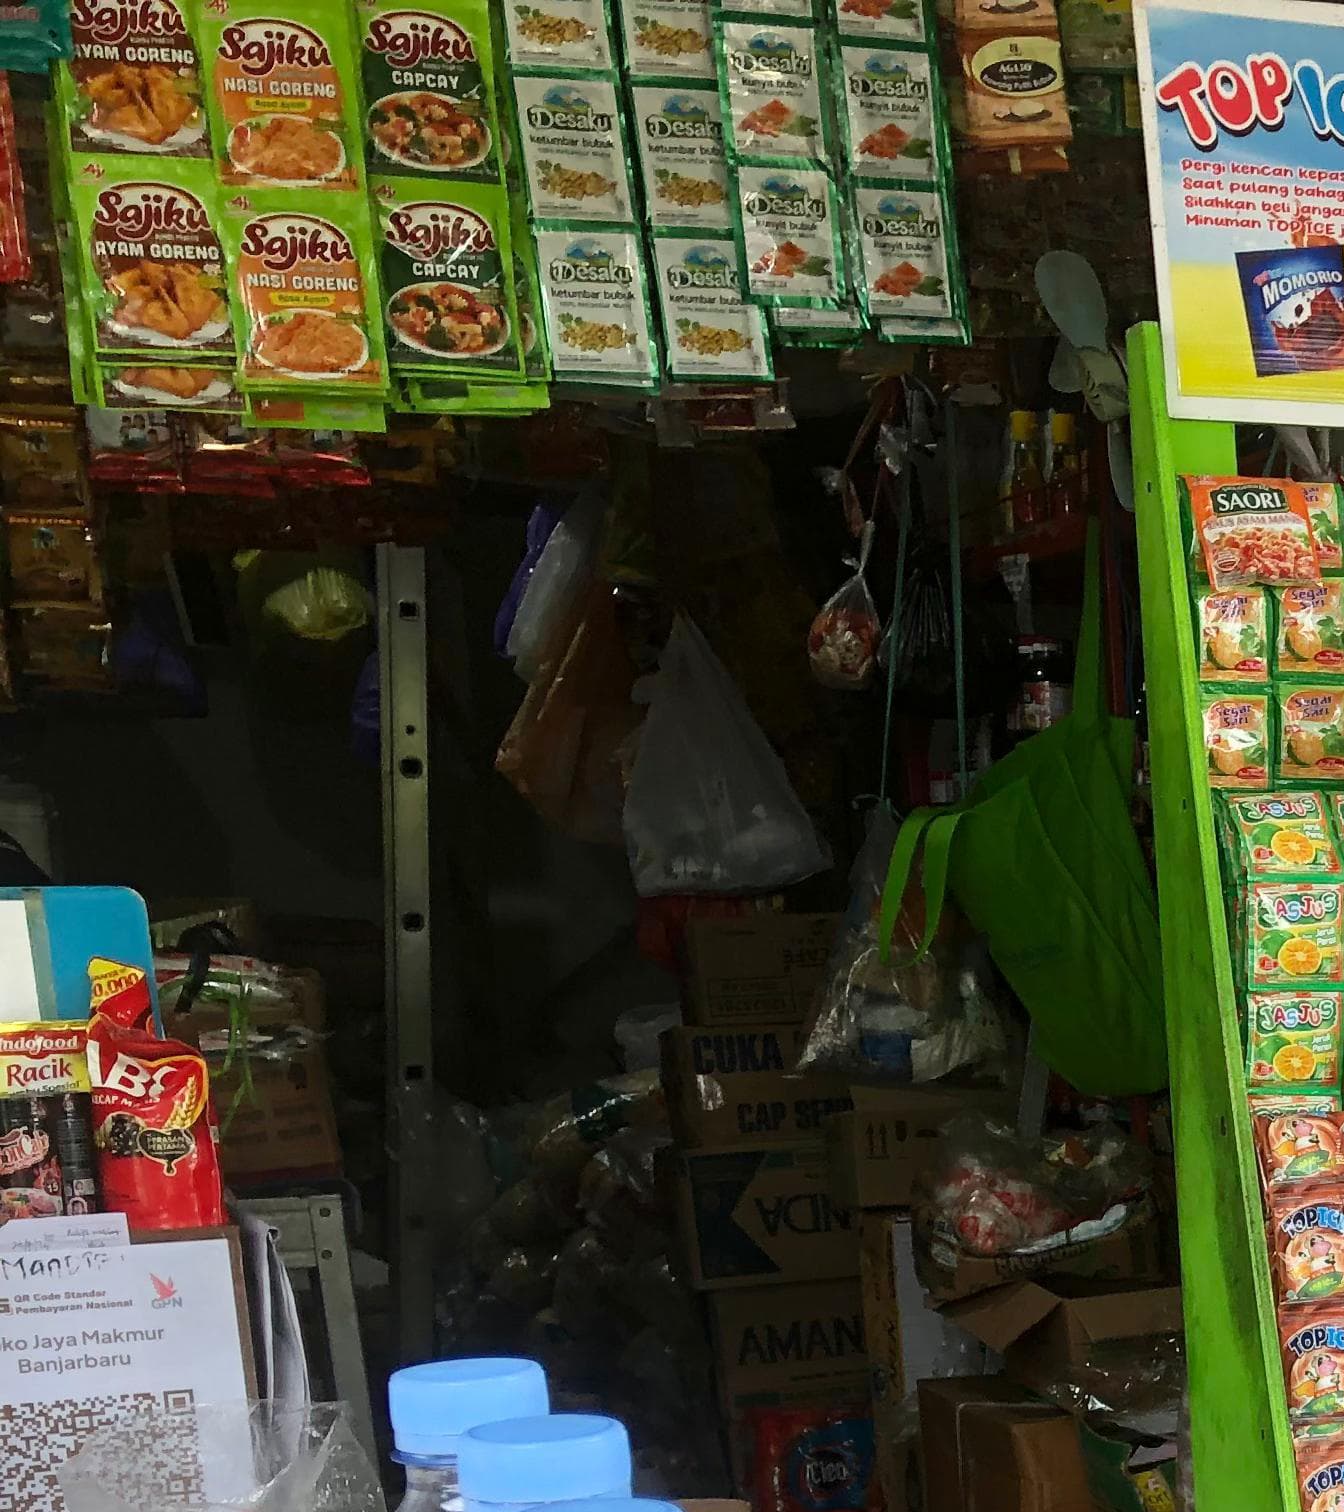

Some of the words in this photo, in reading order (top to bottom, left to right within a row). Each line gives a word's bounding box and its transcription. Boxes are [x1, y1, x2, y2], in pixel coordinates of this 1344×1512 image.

[219, 20, 333, 76] Sajiku
[364, 15, 475, 66] Sajiku
[224, 77, 265, 94] NASI
[269, 80, 336, 99] GORENG
[391, 69, 459, 91] CAPCAY
[1157, 52, 1293, 150] TOP
[527, 107, 613, 132] Desaku
[1181, 158, 1227, 176] Pergi
[1231, 161, 1294, 179] kencan
[1230, 179, 1290, 200] pulang
[94, 190, 209, 242] Sajiku
[1260, 198, 1292, 216] beli
[864, 214, 939, 240] Desaku
[1185, 214, 1262, 231] Minuman
[1267, 216, 1304, 234] TOP
[1306, 218, 1337, 236] ICE
[95, 240, 145, 258] AYAM
[150, 241, 220, 261] GORENG
[1262, 270, 1343, 309] MOMORIO
[1216, 489, 1282, 513] SAORI
[1258, 1001, 1335, 1027] JASJUS
[0, 1035, 79, 1054] ndofood
[6, 1057, 74, 1088] Racik
[14, 1294, 31, 1303] QR
[33, 1293, 61, 1302] Code
[64, 1290, 107, 1300] Standar
[15, 1303, 83, 1315] Pembayaran
[86, 1299, 134, 1310] Nasional
[151, 1297, 183, 1310] GPN
[32, 1334, 78, 1352] Jaya
[82, 1328, 166, 1347] Makmur
[18, 1353, 132, 1375] Banjarbaru
[1305, 1468, 1343, 1497] TOP
